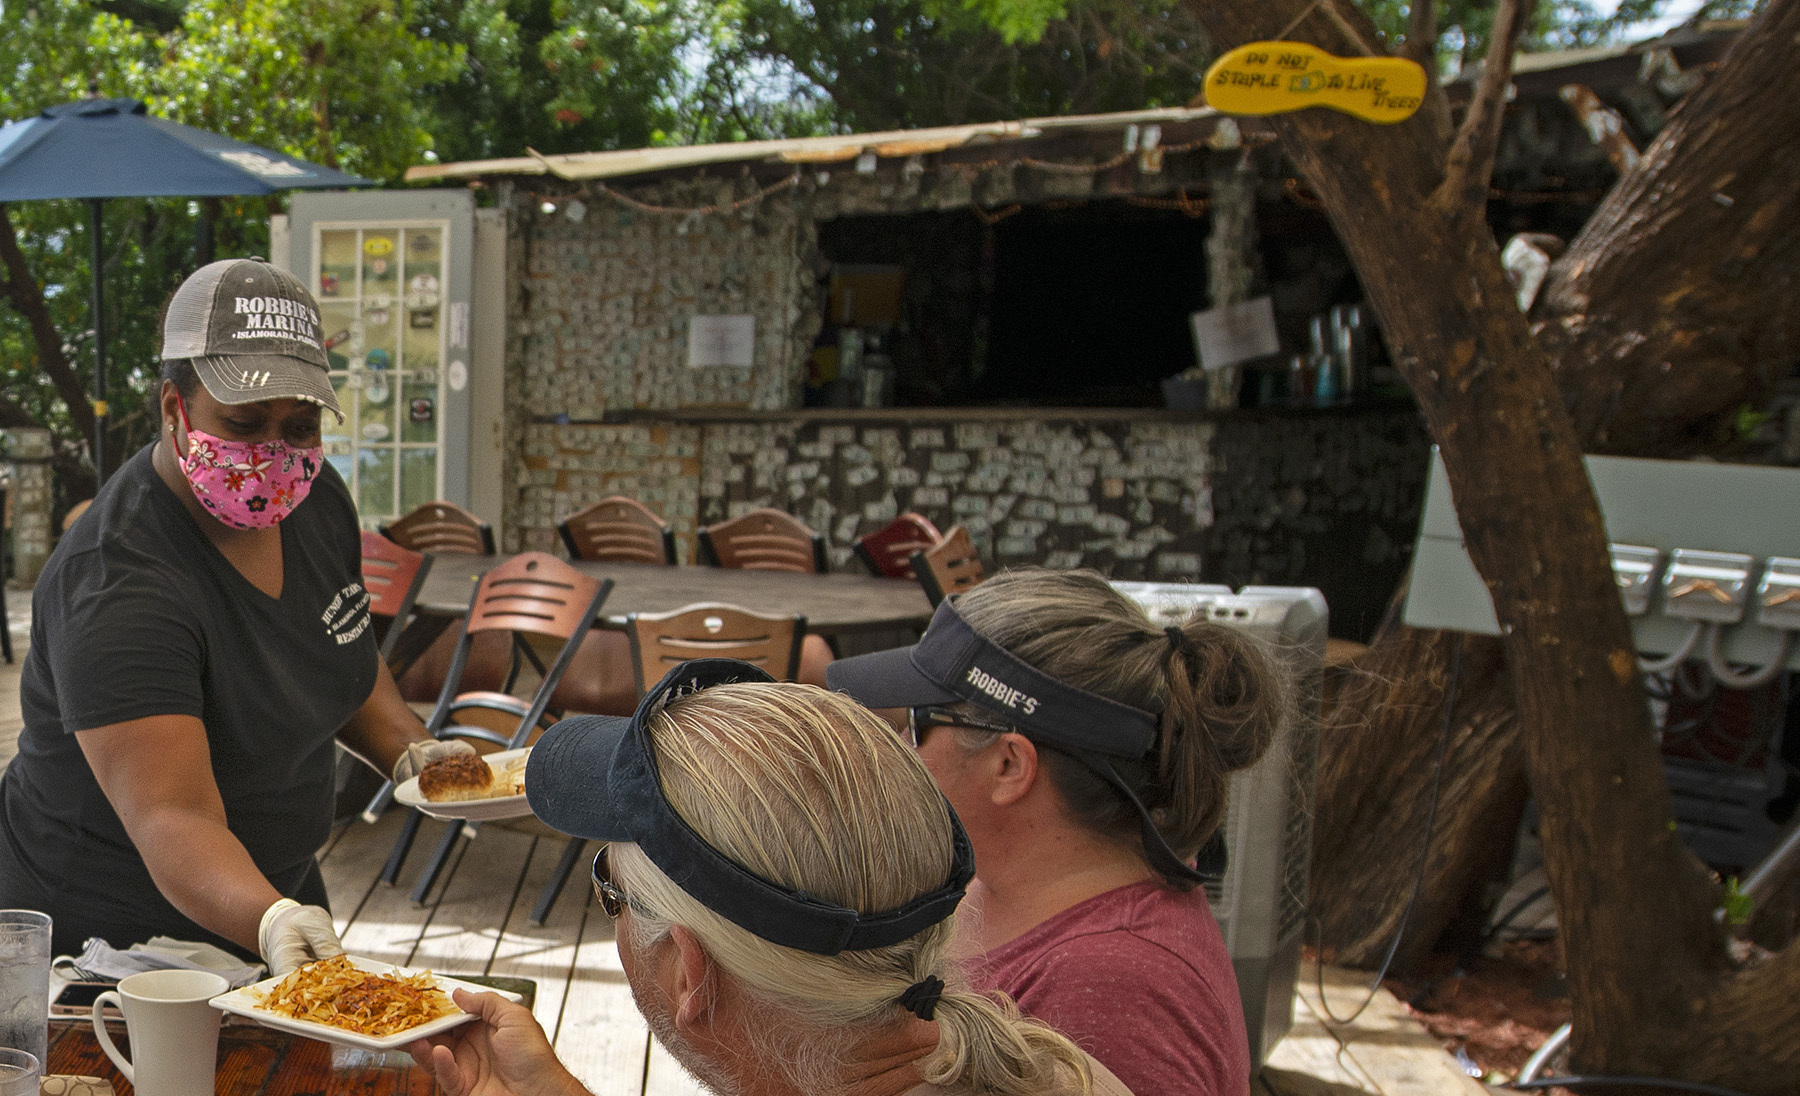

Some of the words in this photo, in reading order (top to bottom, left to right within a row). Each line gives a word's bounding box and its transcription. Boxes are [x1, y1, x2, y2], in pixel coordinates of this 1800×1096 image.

[1246, 52, 1269, 64] DO
[1277, 53, 1314, 70] NOT
[234, 297, 319, 326] ROBBIE'S
[246, 314, 315, 338] MARINA
[967, 666, 1041, 715] ROBBIE'S
